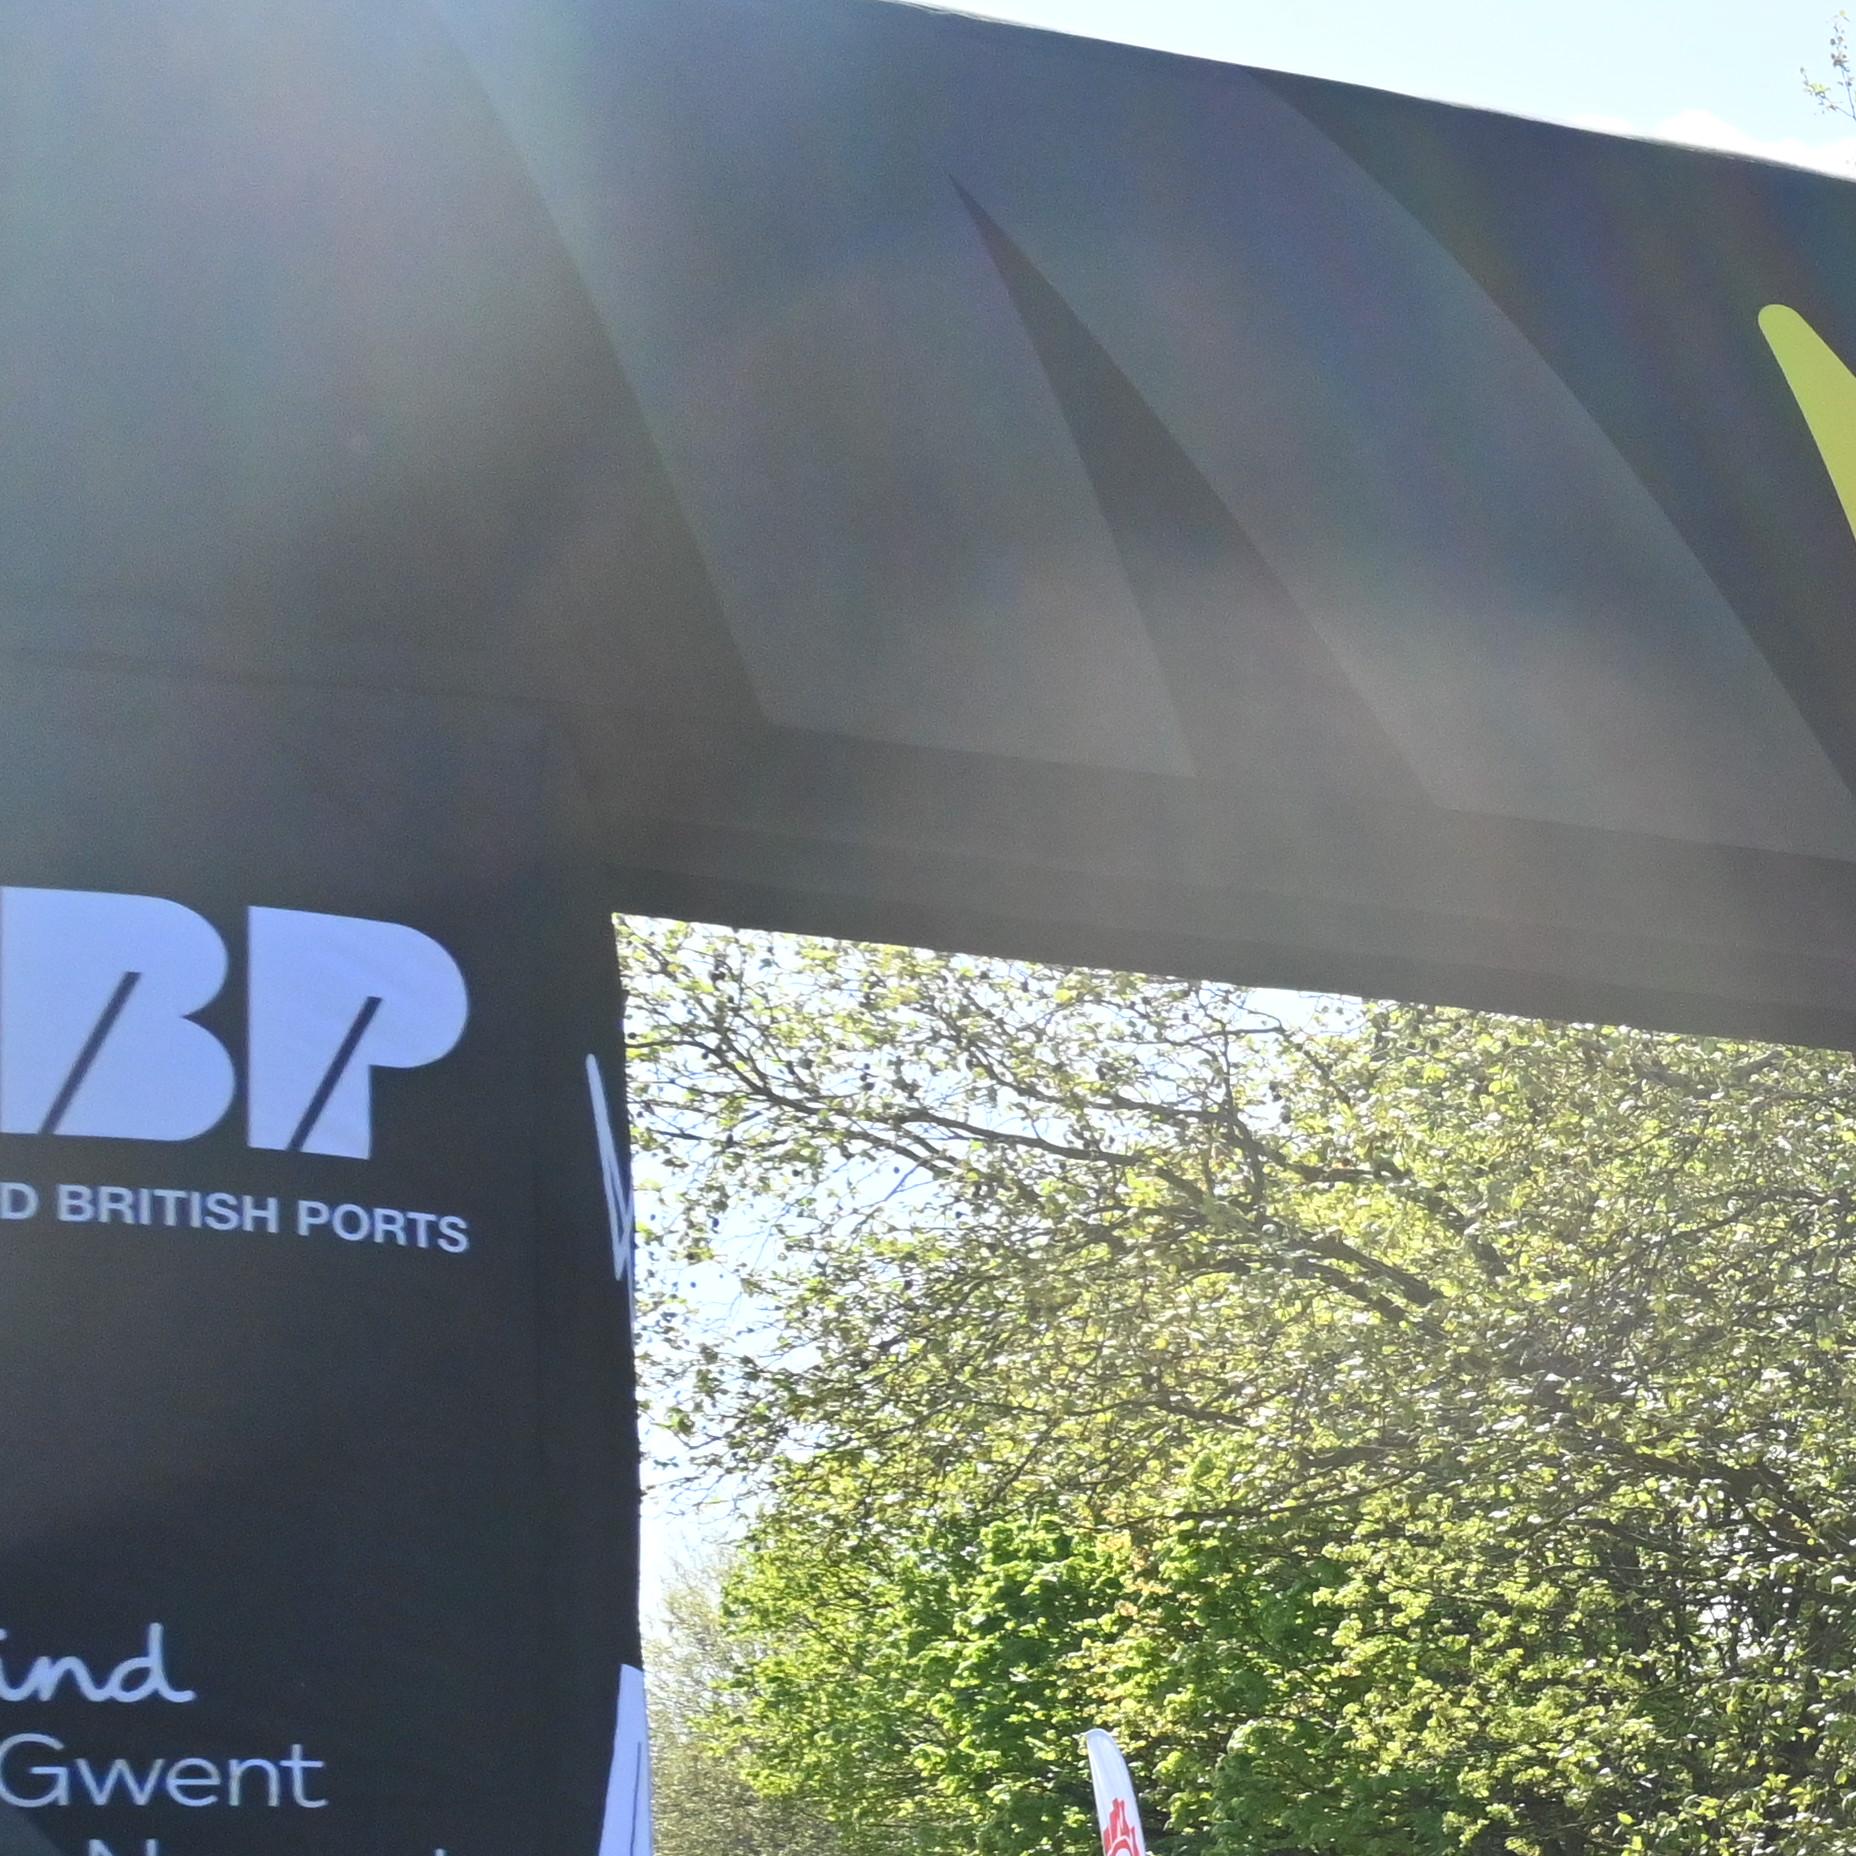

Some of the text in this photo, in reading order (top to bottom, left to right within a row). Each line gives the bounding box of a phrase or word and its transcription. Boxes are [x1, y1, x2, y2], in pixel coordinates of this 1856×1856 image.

[0, 886, 468, 1160] BP
[57, 1184, 279, 1234] BRITISH
[297, 1200, 469, 1254] PORTS
[0, 1622, 197, 1702] ind
[0, 1732, 328, 1808] Gwent
